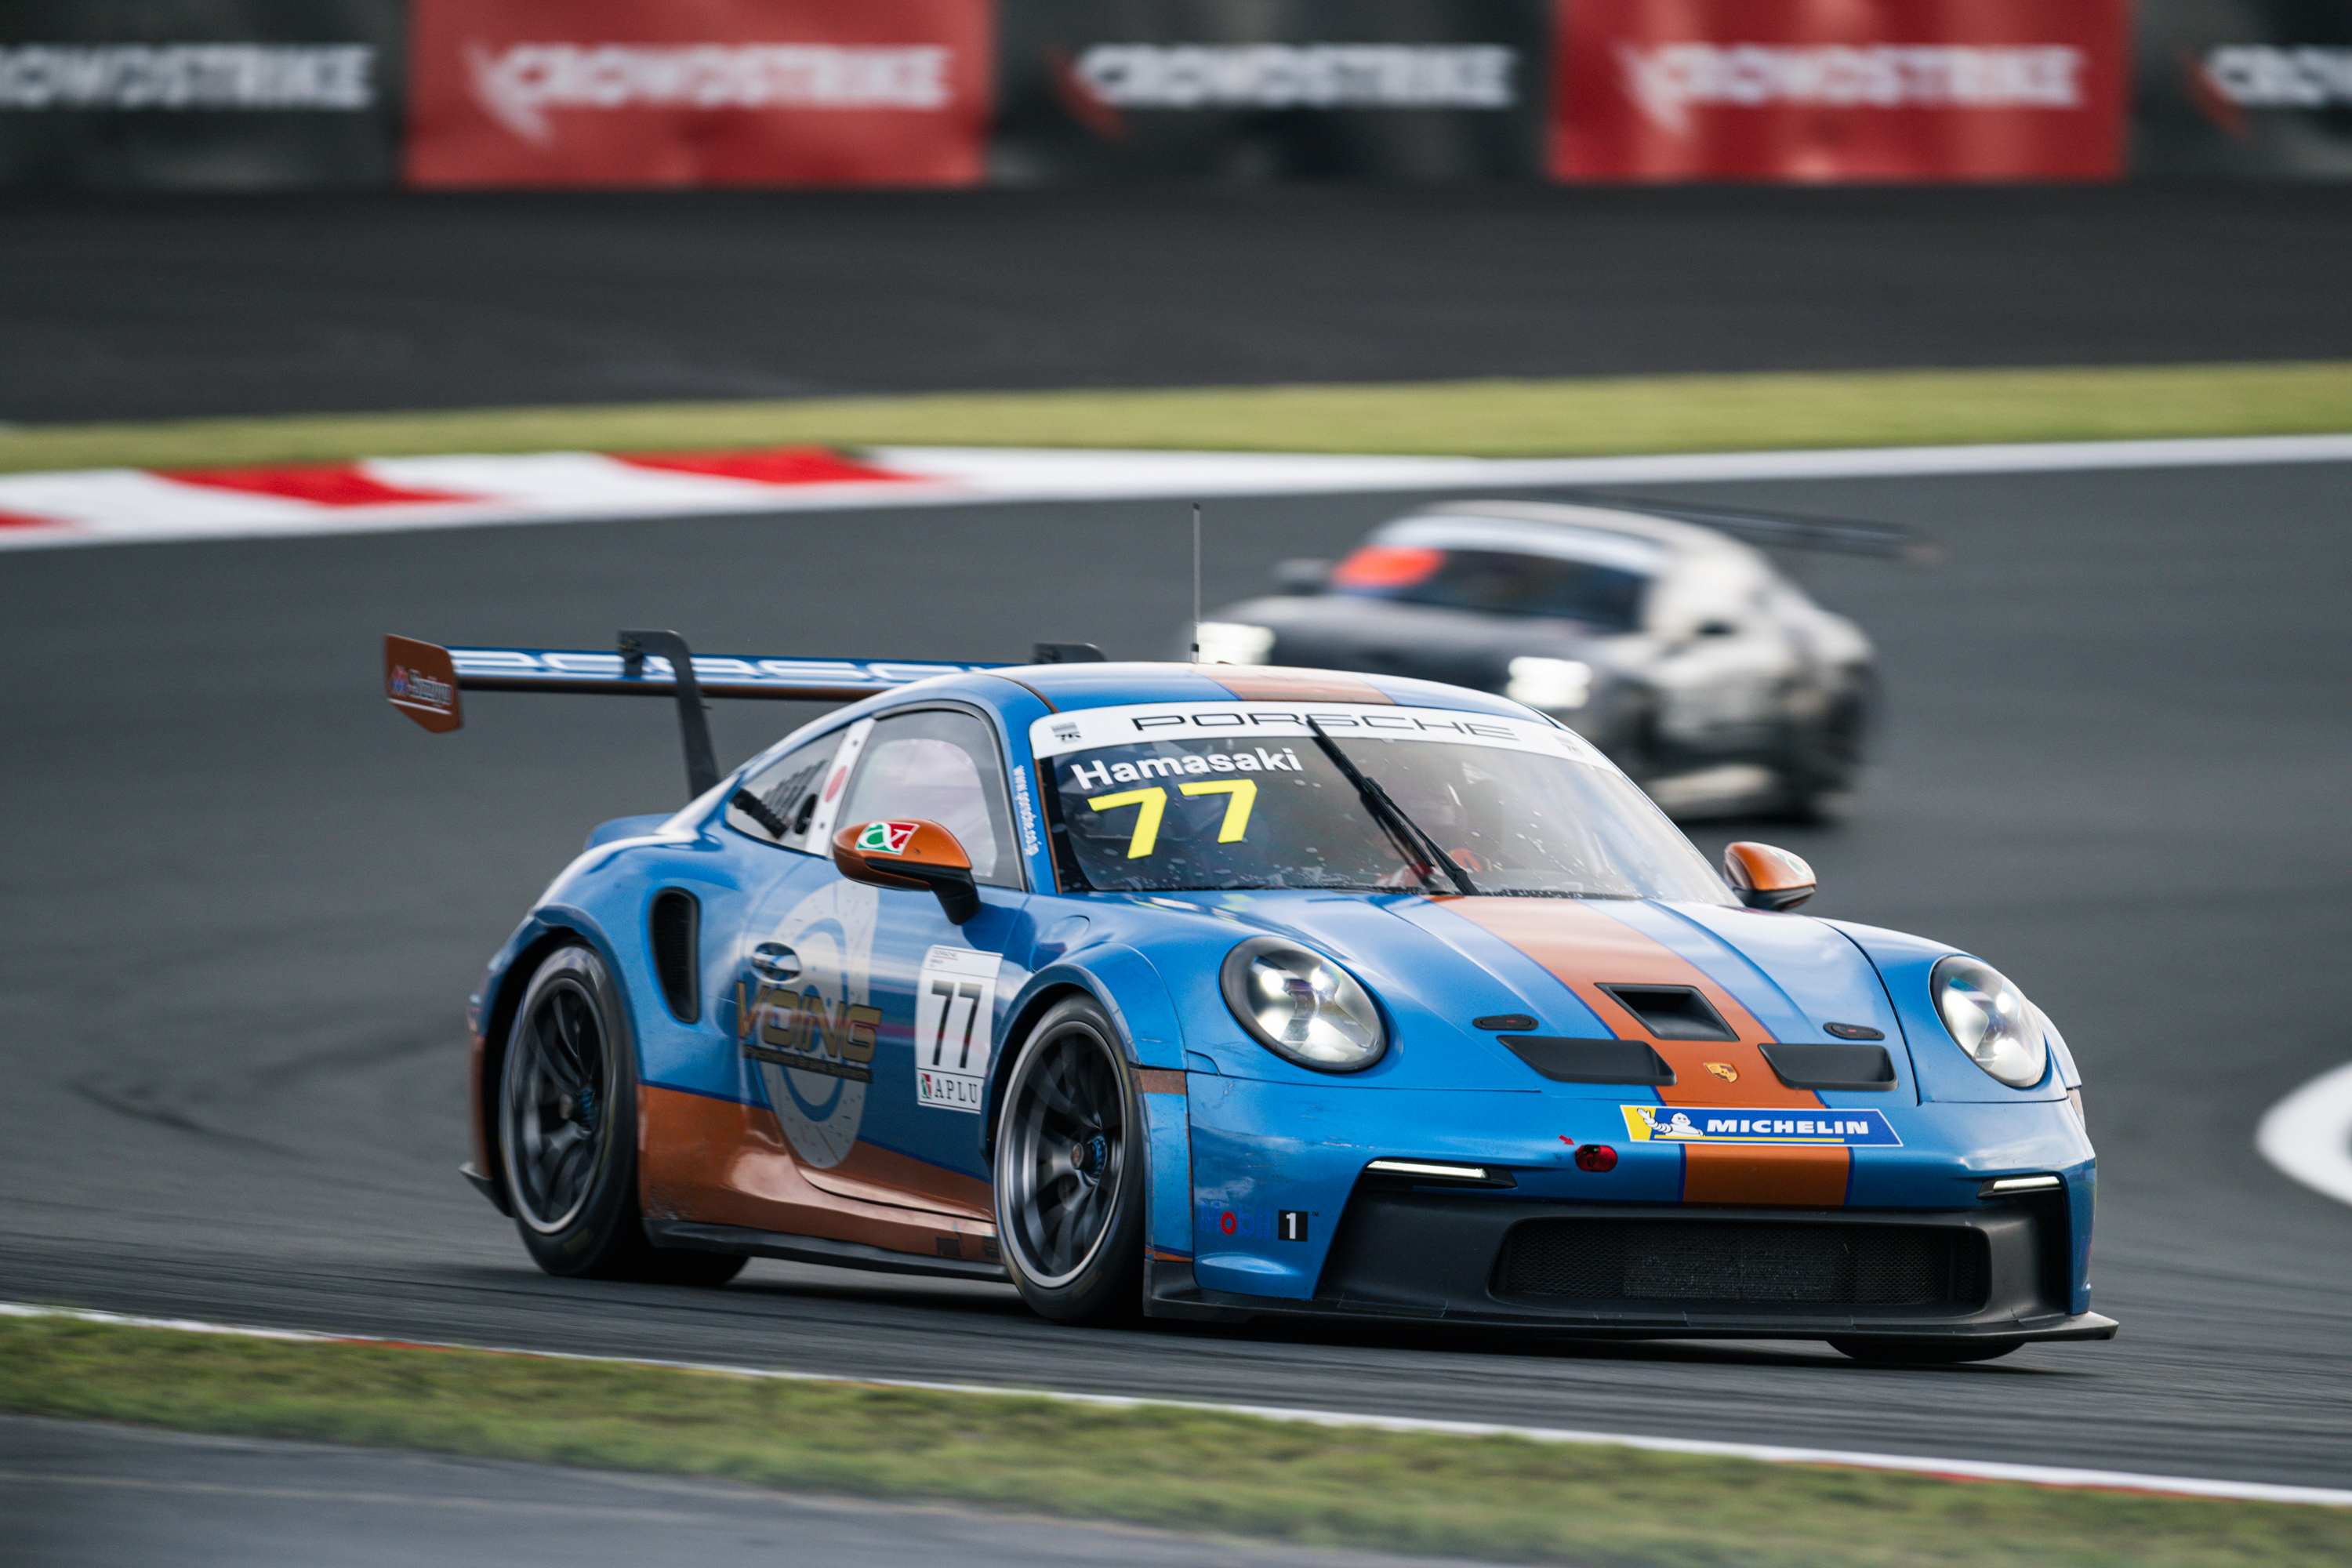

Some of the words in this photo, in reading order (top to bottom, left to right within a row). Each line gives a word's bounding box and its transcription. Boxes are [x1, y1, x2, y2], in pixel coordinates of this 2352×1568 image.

[0, 45, 372, 107] OWDSTRIKE
[1131, 712, 1520, 741] PORSCHE
[1070, 747, 1302, 789] Hamasaki
[1087, 779, 1258, 859] 77
[931, 979, 982, 1069] 77
[1706, 1117, 1869, 1135] MICHELIN
[1286, 1212, 1297, 1240] 1
